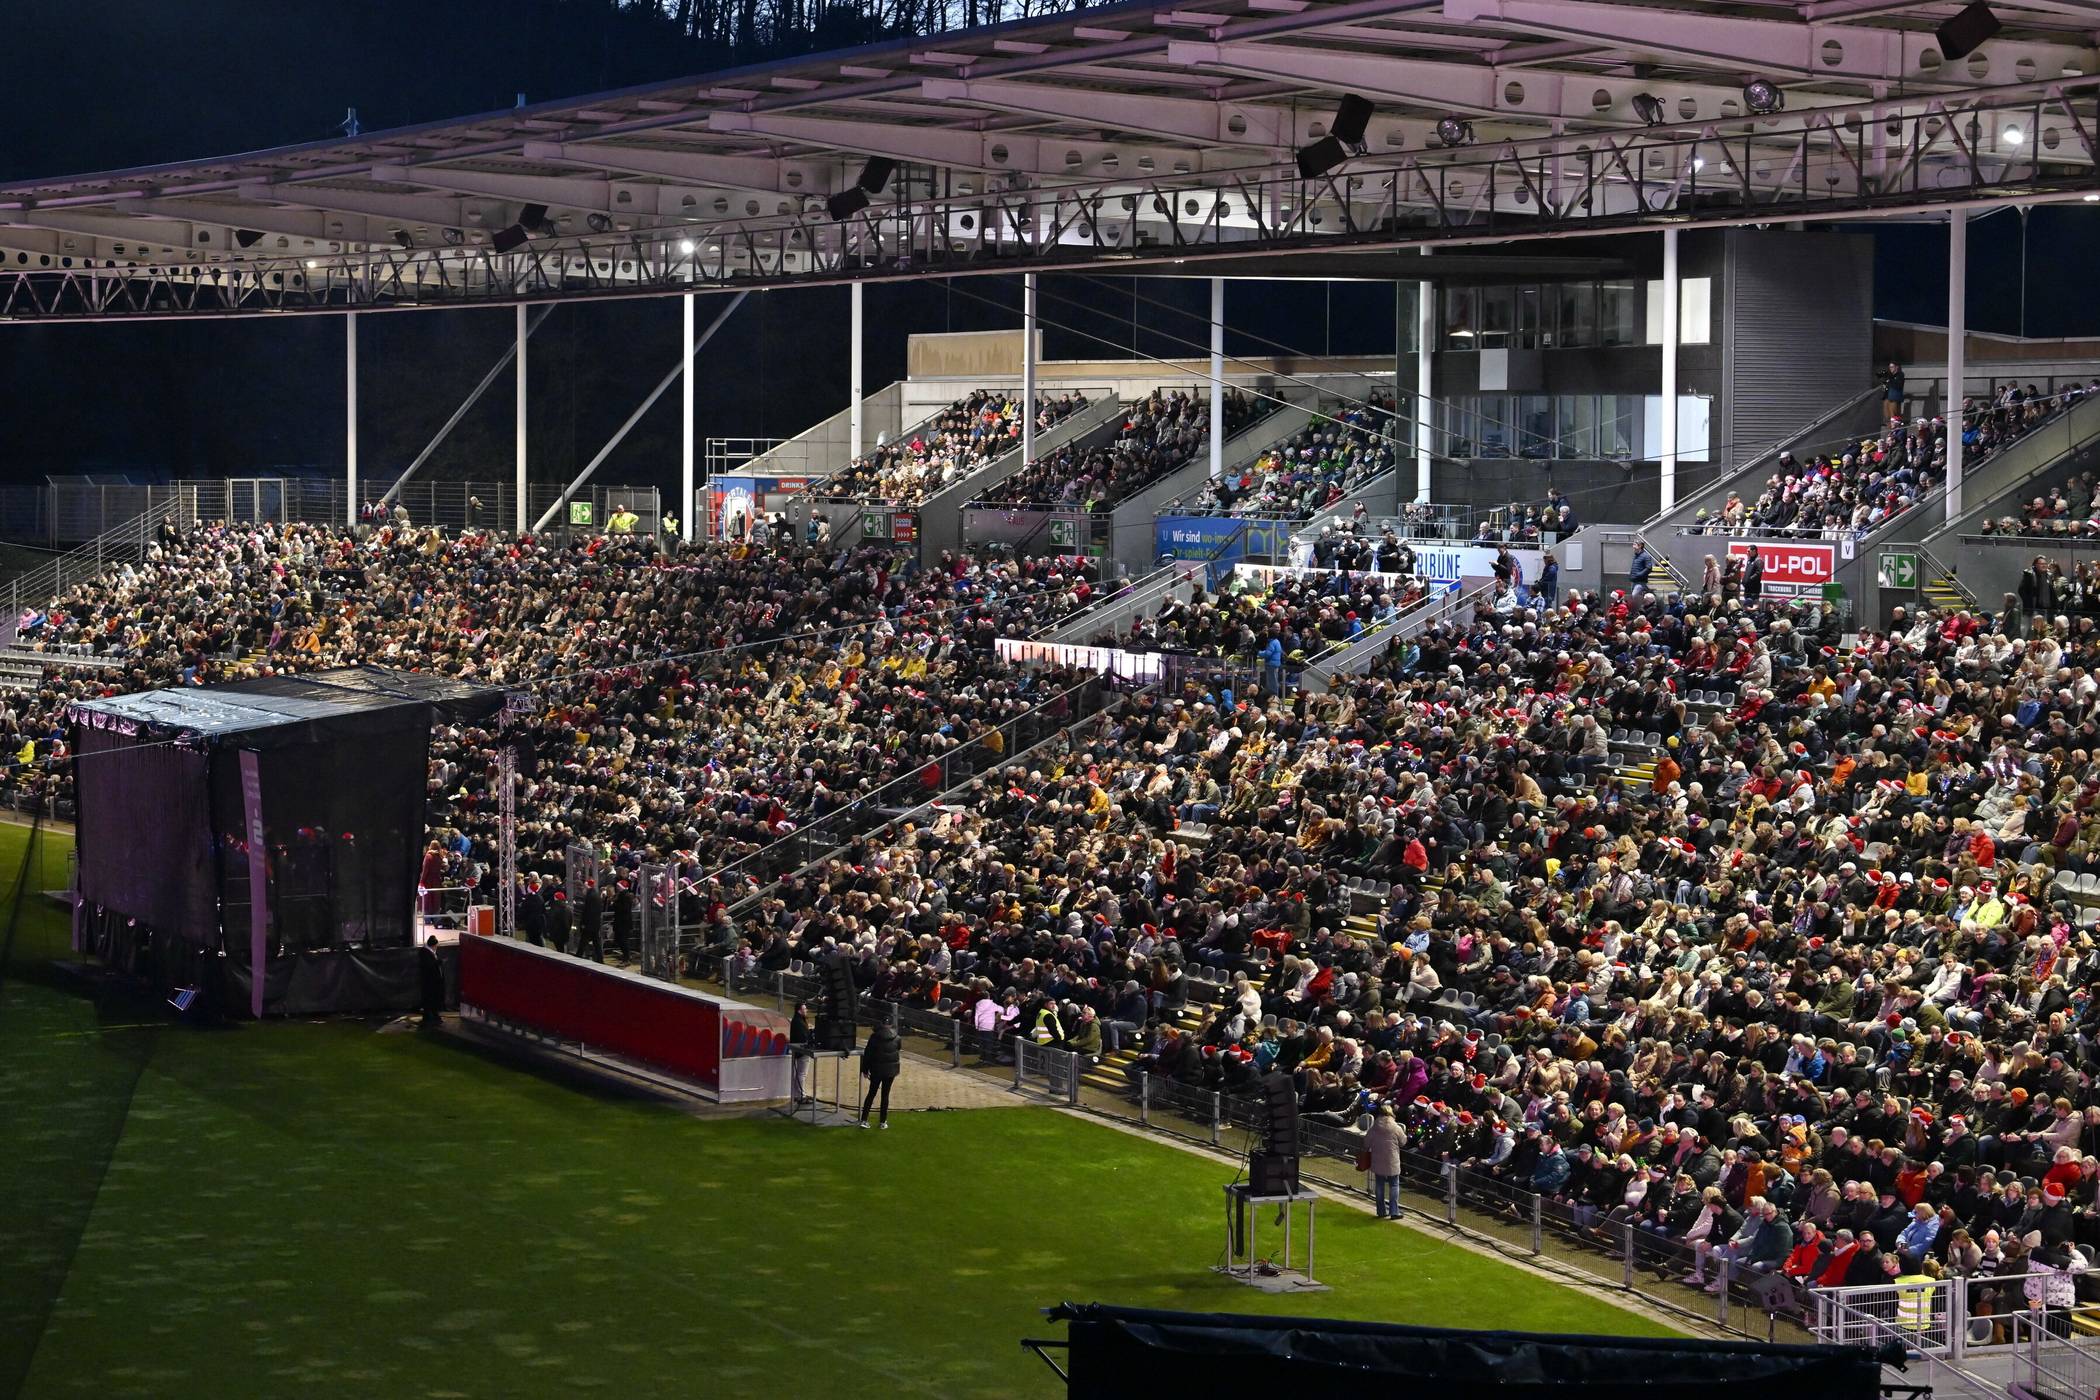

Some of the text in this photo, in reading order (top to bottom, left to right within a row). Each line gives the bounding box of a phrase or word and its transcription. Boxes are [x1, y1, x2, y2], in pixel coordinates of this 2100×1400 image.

[781, 481, 804, 489] DRINKS
[1172, 530, 1185, 542] Wir
[1185, 530, 1201, 543] sind
[1845, 545, 1850, 555] V
[1416, 549, 1461, 579] RIBÜNE
